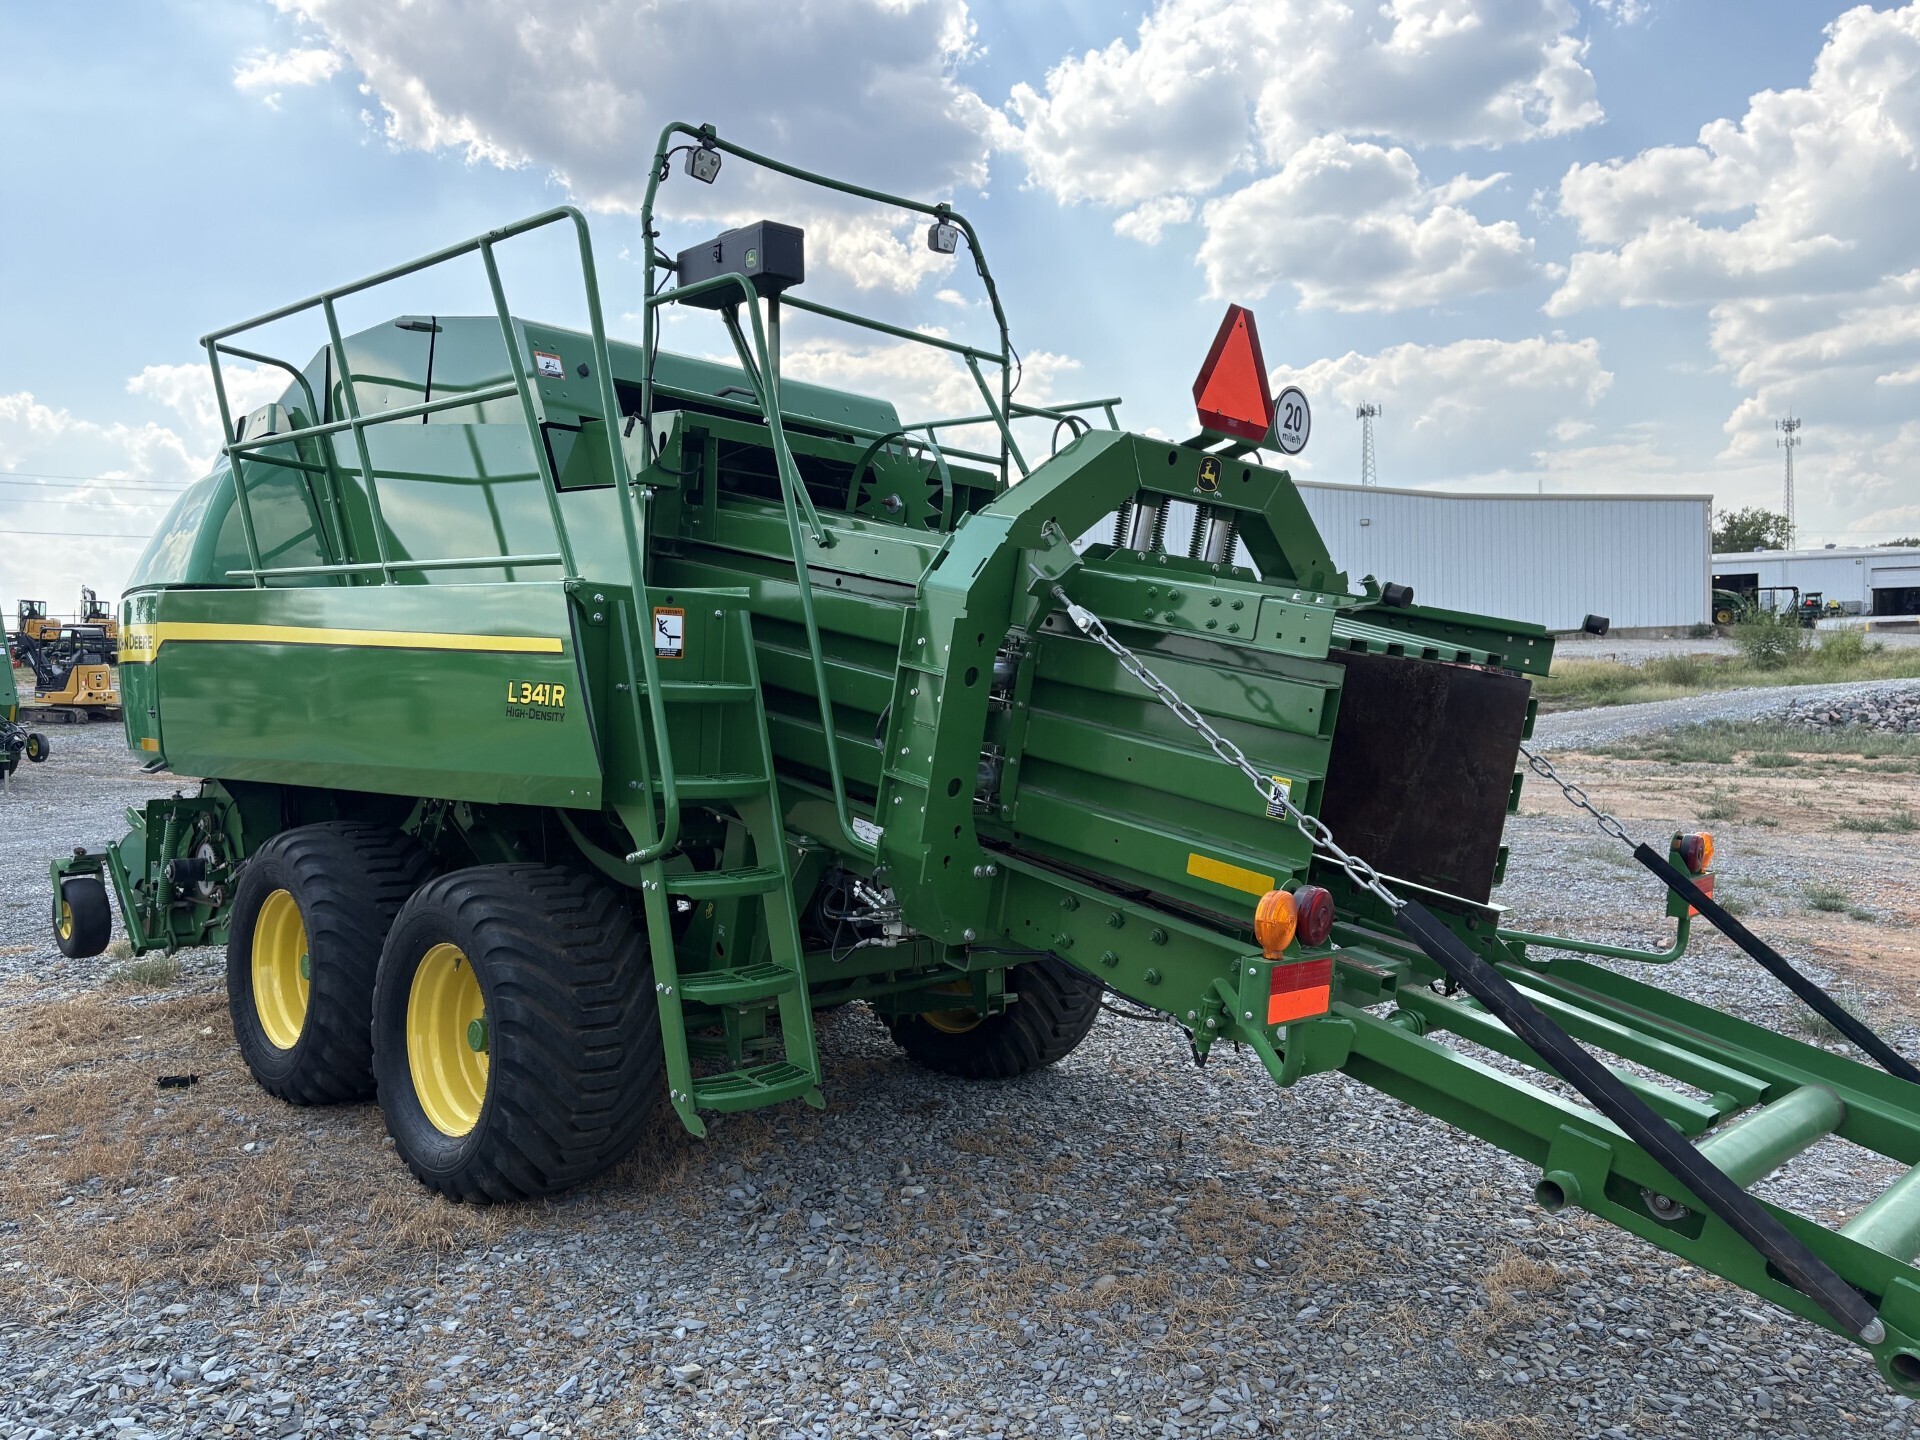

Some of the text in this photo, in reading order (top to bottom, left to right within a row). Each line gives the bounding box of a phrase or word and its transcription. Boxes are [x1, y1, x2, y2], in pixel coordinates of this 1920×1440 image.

[1284, 402, 1302, 432] 20
[1282, 433, 1301, 445] mile/h
[129, 634, 153, 650] DEERE
[507, 680, 566, 708] L341R
